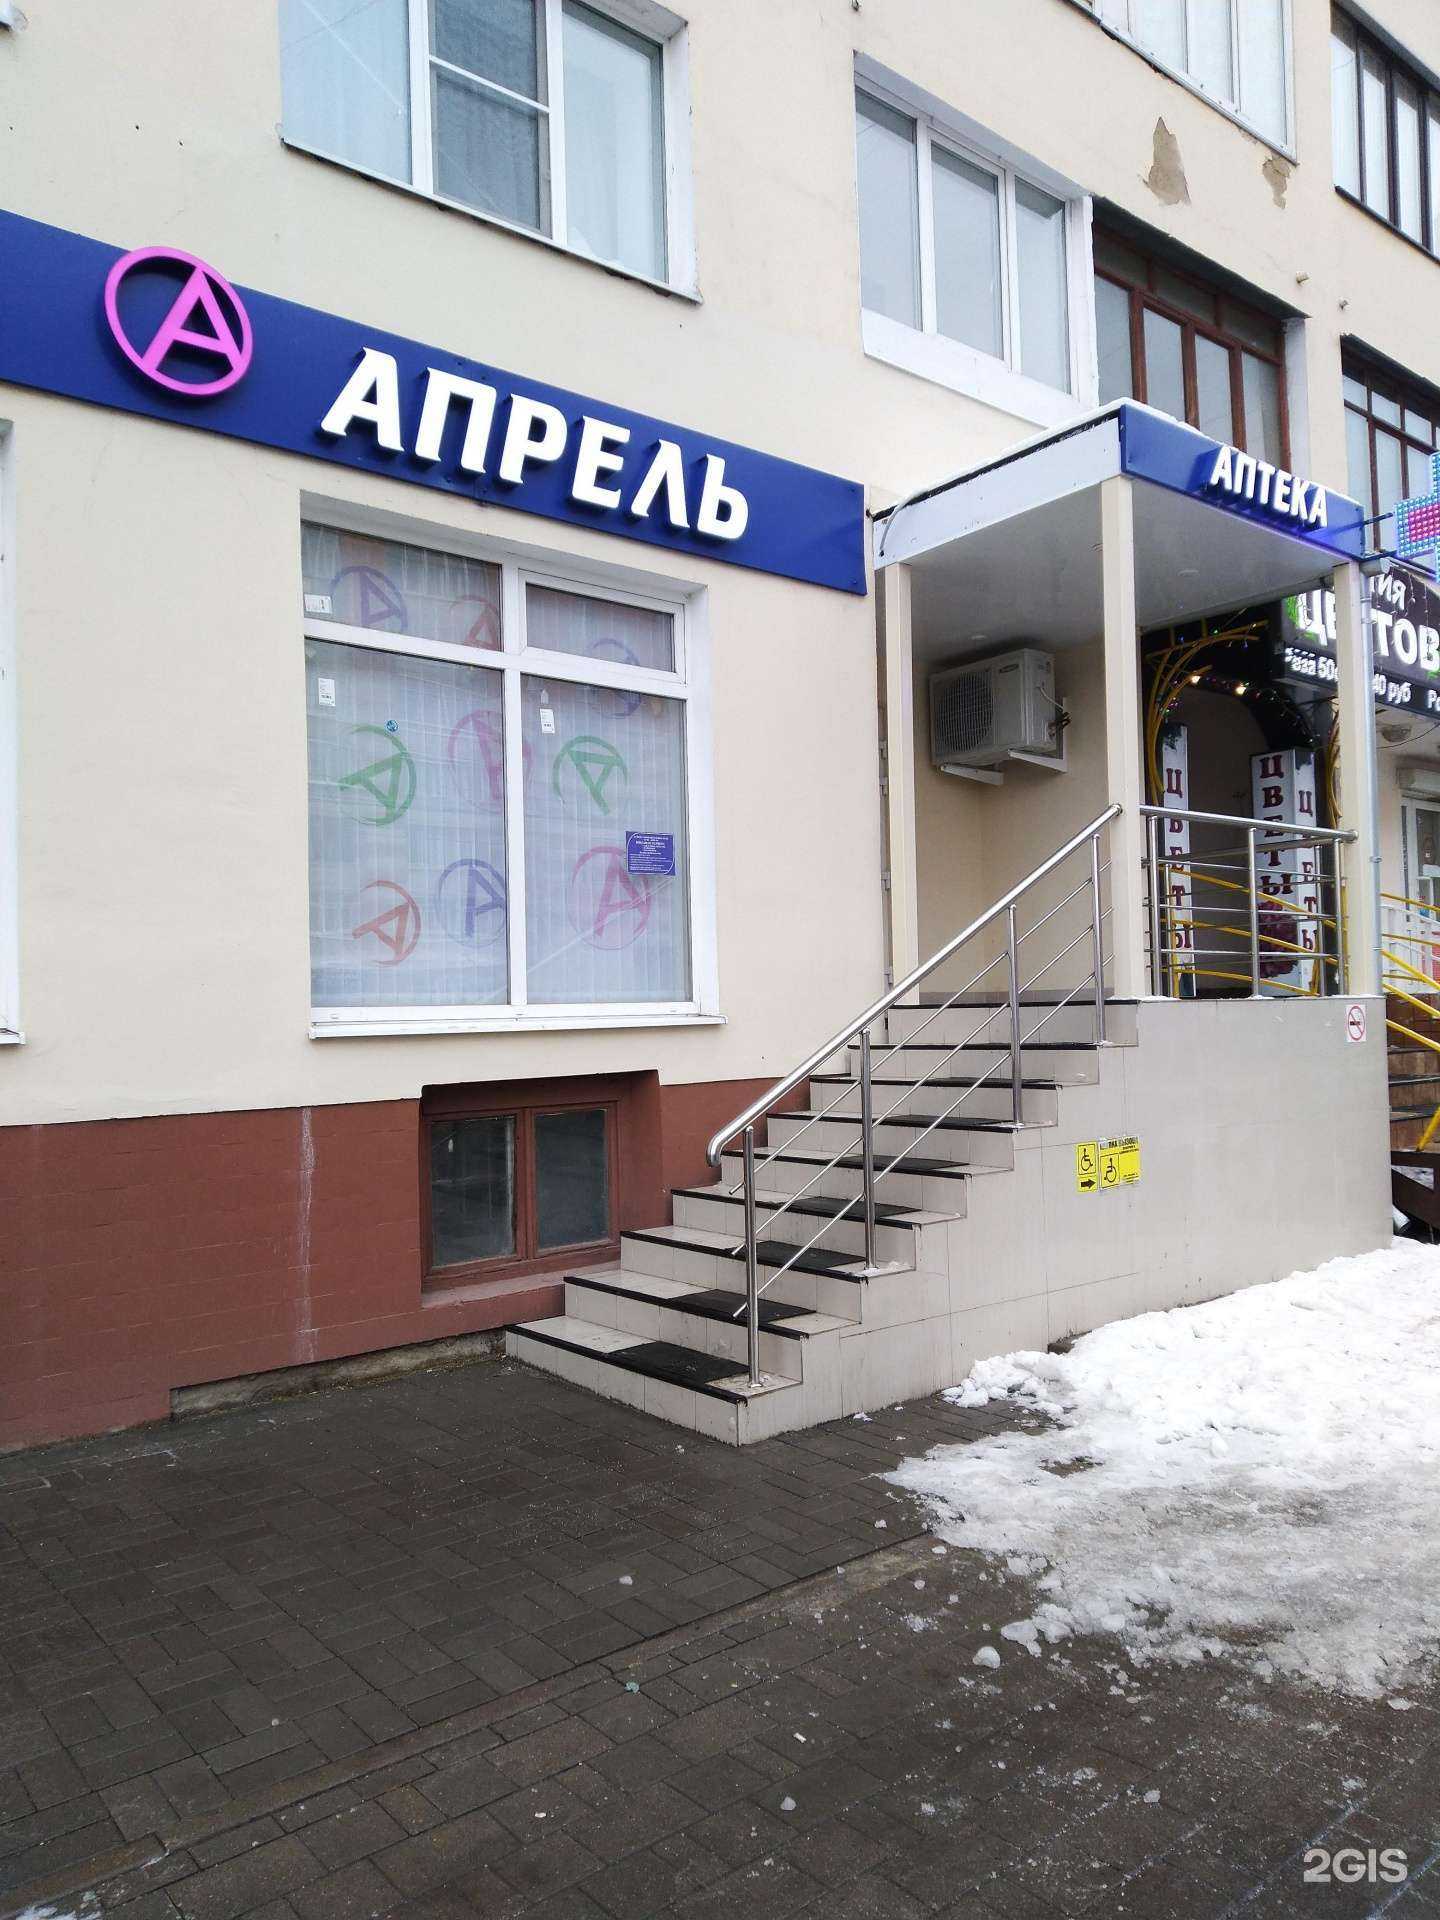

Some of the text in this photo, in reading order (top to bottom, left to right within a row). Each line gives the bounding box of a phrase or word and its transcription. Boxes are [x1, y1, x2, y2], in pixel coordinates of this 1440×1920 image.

[321, 346, 748, 540] АПРЕЛЬ
[1209, 446, 1328, 528] АПТЕКА
[1297, 588, 1440, 672] ЦТОВ
[1260, 754, 1294, 895] ЦВЕТЫ
[1299, 790, 1319, 950] ЦЕТЫ
